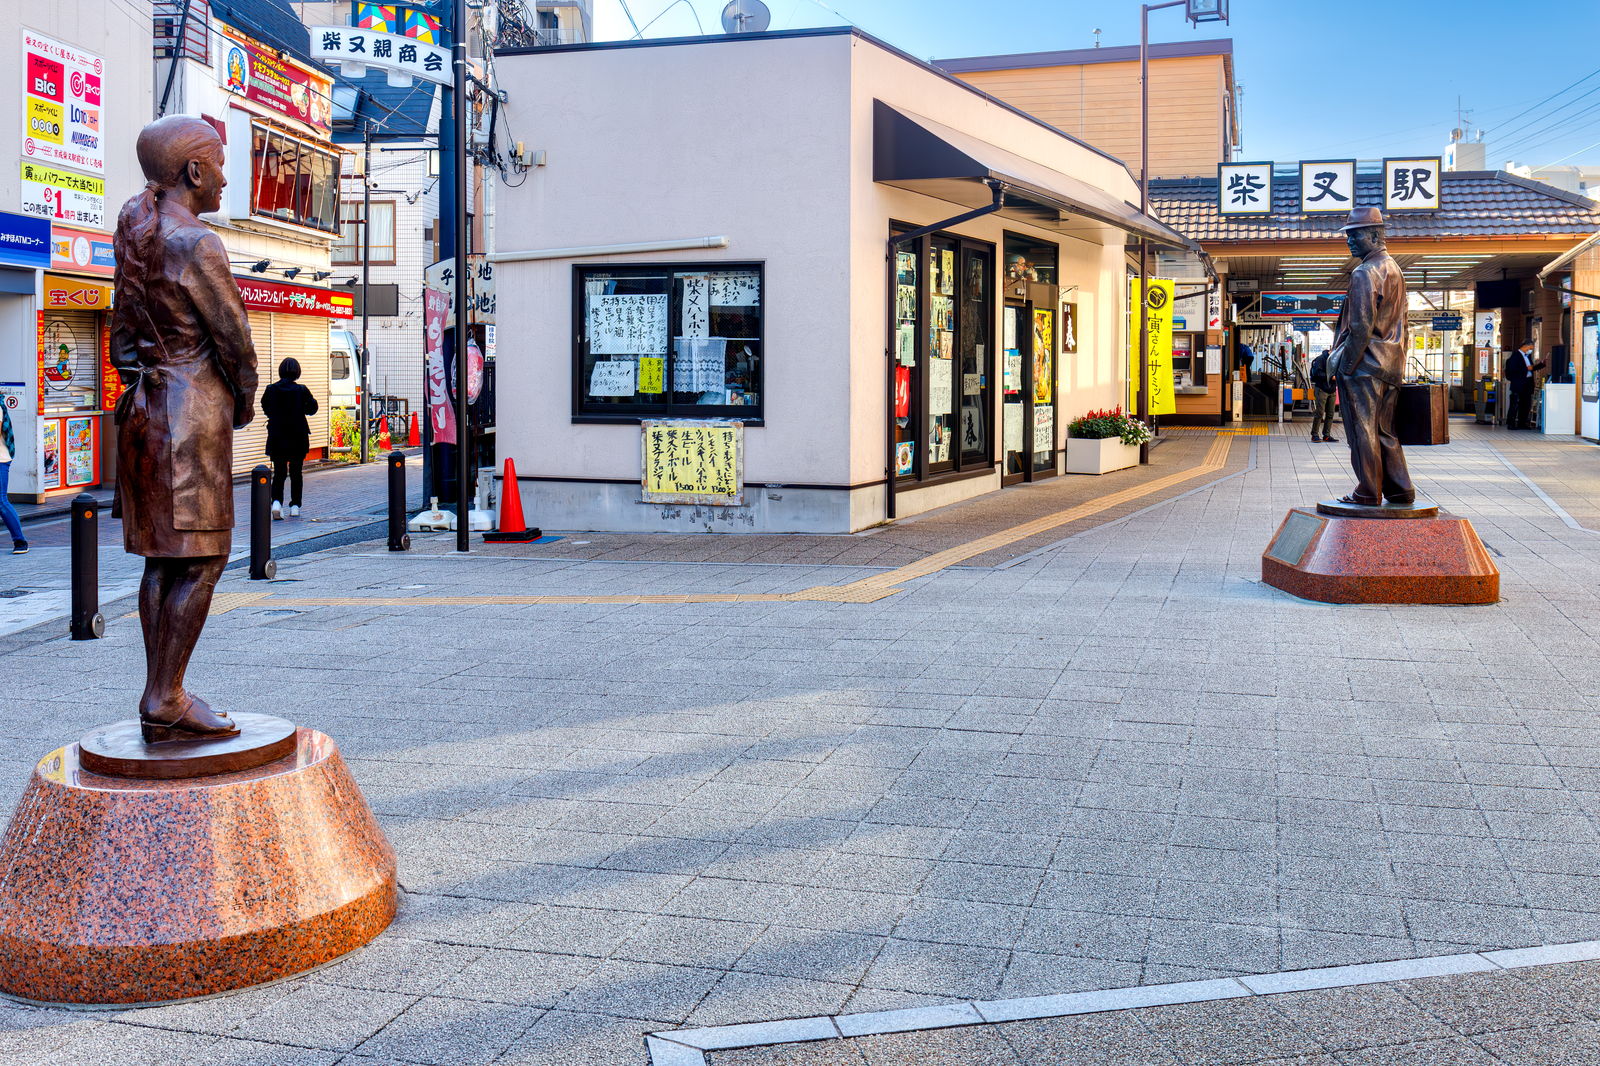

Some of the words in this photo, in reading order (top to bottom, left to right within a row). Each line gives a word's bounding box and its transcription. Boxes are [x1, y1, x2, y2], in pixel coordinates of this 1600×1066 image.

[322, 31, 443, 71] 柴又親商会
[34, 77, 57, 96] BIG
[71, 104, 88, 124] LOTO
[31, 116, 60, 136] toto
[71, 131, 99, 149] NUMBERS
[1227, 168, 1435, 205] 柴又駅
[49, 289, 99, 306] 宝くじ
[681, 430, 696, 466] 生ビール
[708, 431, 718, 467] レモンハイ
